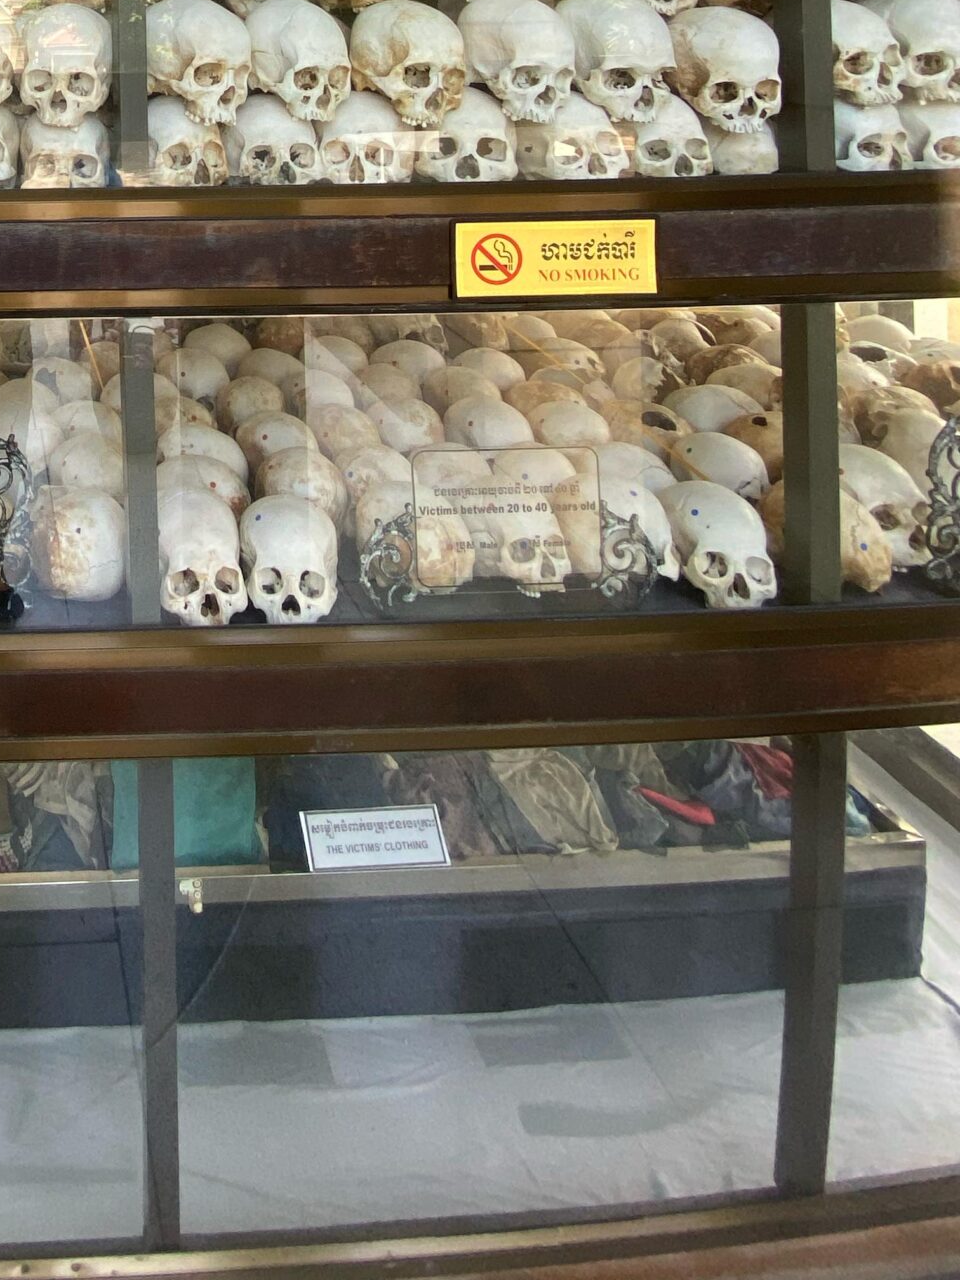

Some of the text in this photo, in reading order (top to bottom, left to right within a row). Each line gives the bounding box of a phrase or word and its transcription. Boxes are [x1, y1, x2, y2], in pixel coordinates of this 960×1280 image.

[541, 230, 636, 261] ហាមជក់បារី
[538, 267, 640, 282] NO SMOKING
[418, 505, 458, 516] Victims
[460, 503, 505, 515] between
[507, 503, 520, 513] 20
[522, 503, 533, 513] to
[534, 502, 548, 512] 40
[580, 500, 596, 511] old
[326, 845, 344, 854] THE
[384, 839, 429, 852] CLOTHING
